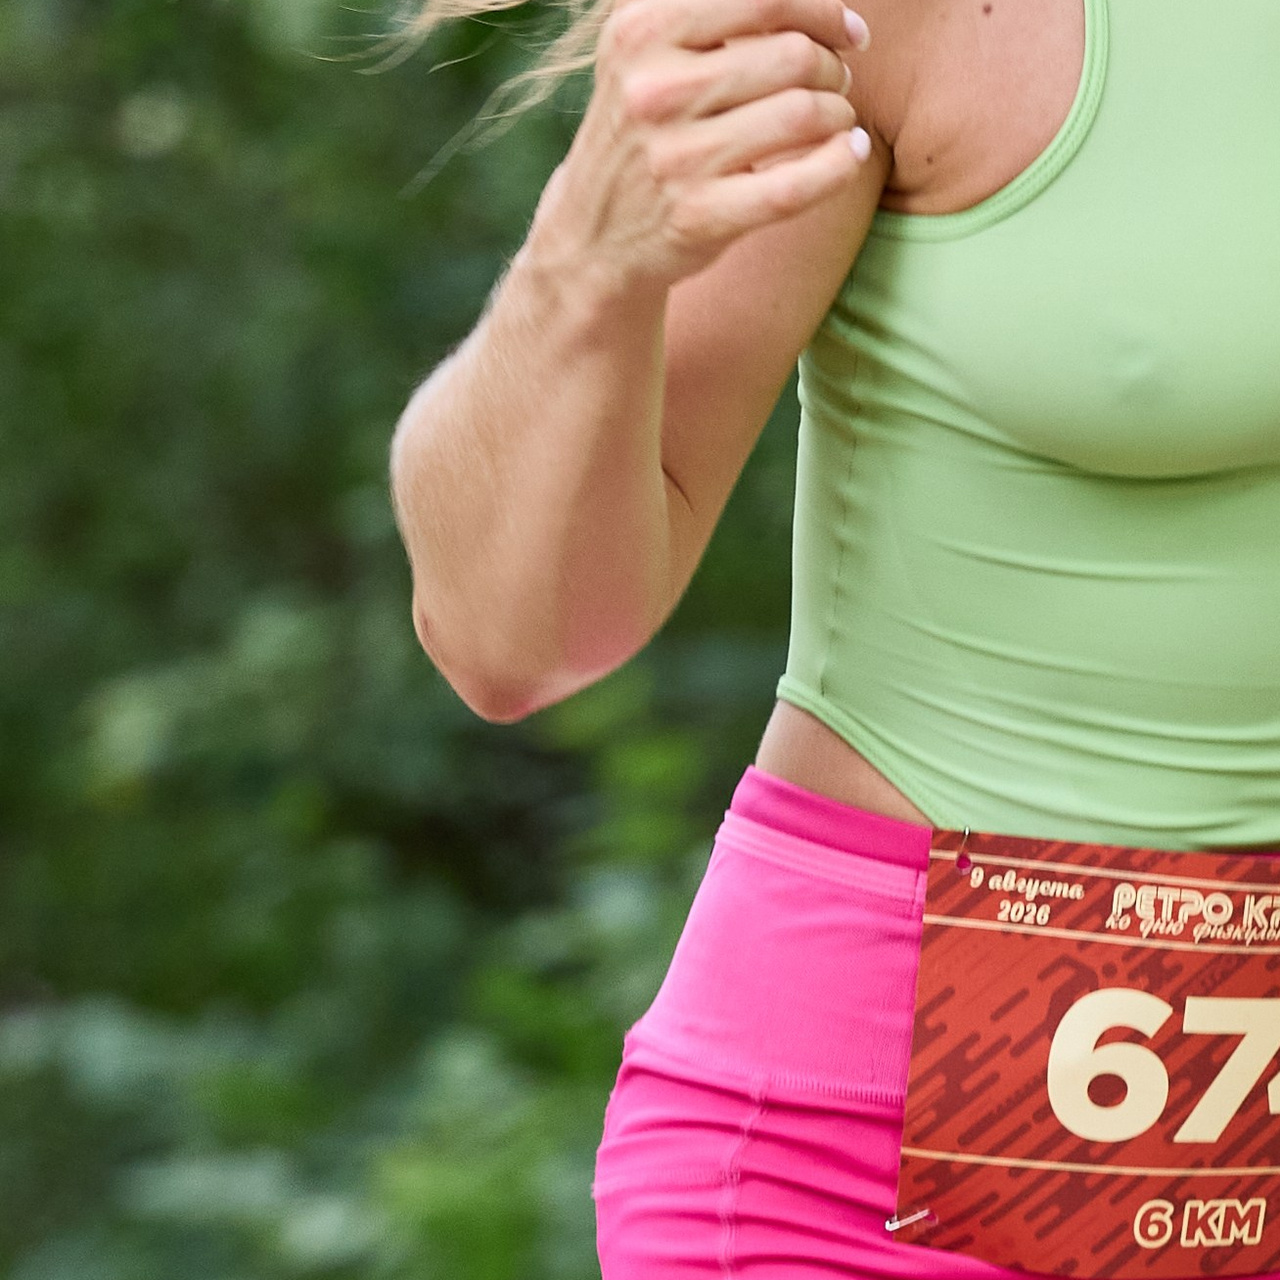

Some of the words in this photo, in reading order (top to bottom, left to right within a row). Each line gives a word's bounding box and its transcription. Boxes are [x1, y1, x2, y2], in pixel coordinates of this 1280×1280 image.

[970, 867, 984, 888] 9
[989, 870, 1085, 901] августа
[997, 899, 1051, 925] 2026
[1112, 884, 1233, 926] РЕТРО
[1105, 913, 1131, 930] ко
[1139, 919, 1184, 939] дню
[1133, 1199, 1175, 1249] 6
[1180, 1197, 1267, 1248] КМ
